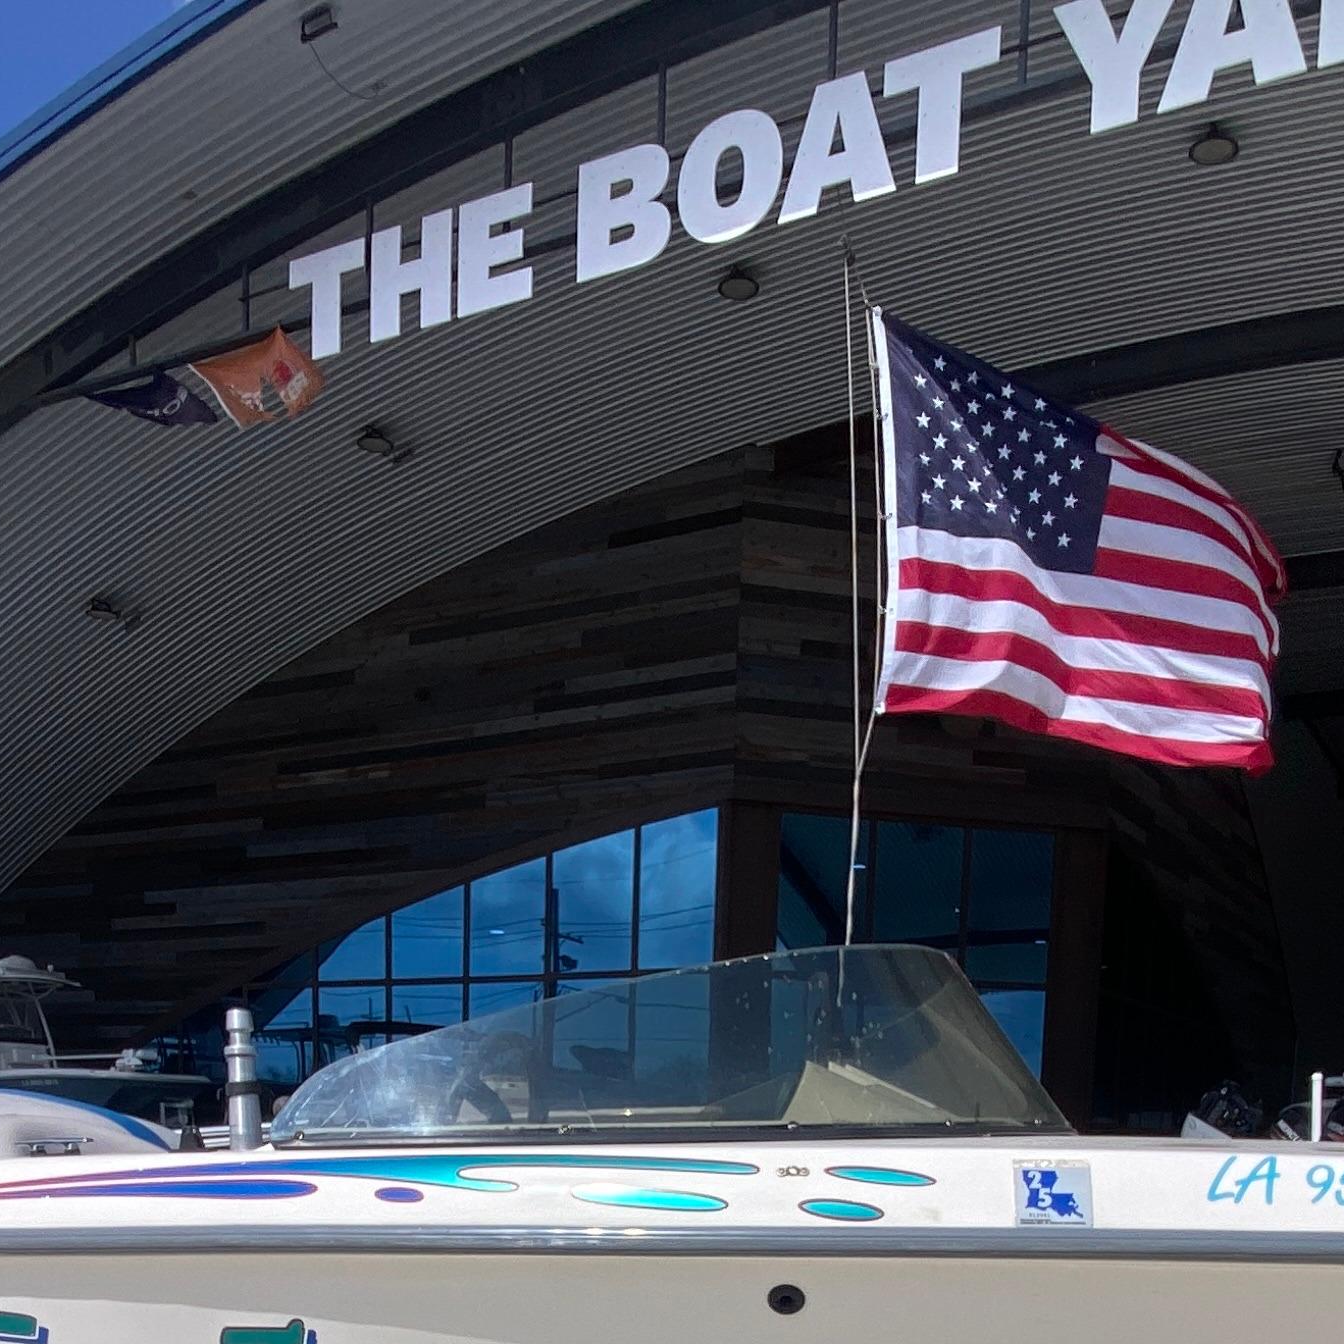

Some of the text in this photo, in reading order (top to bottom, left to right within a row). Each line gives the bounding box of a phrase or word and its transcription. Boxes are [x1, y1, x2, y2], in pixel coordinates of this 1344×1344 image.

[288, 182, 533, 360] THE
[575, 26, 1002, 283] BOAT
[1027, 1170, 1043, 1189] 2
[1207, 1155, 1282, 1205] LA
[1037, 1188, 1053, 1208] 5
